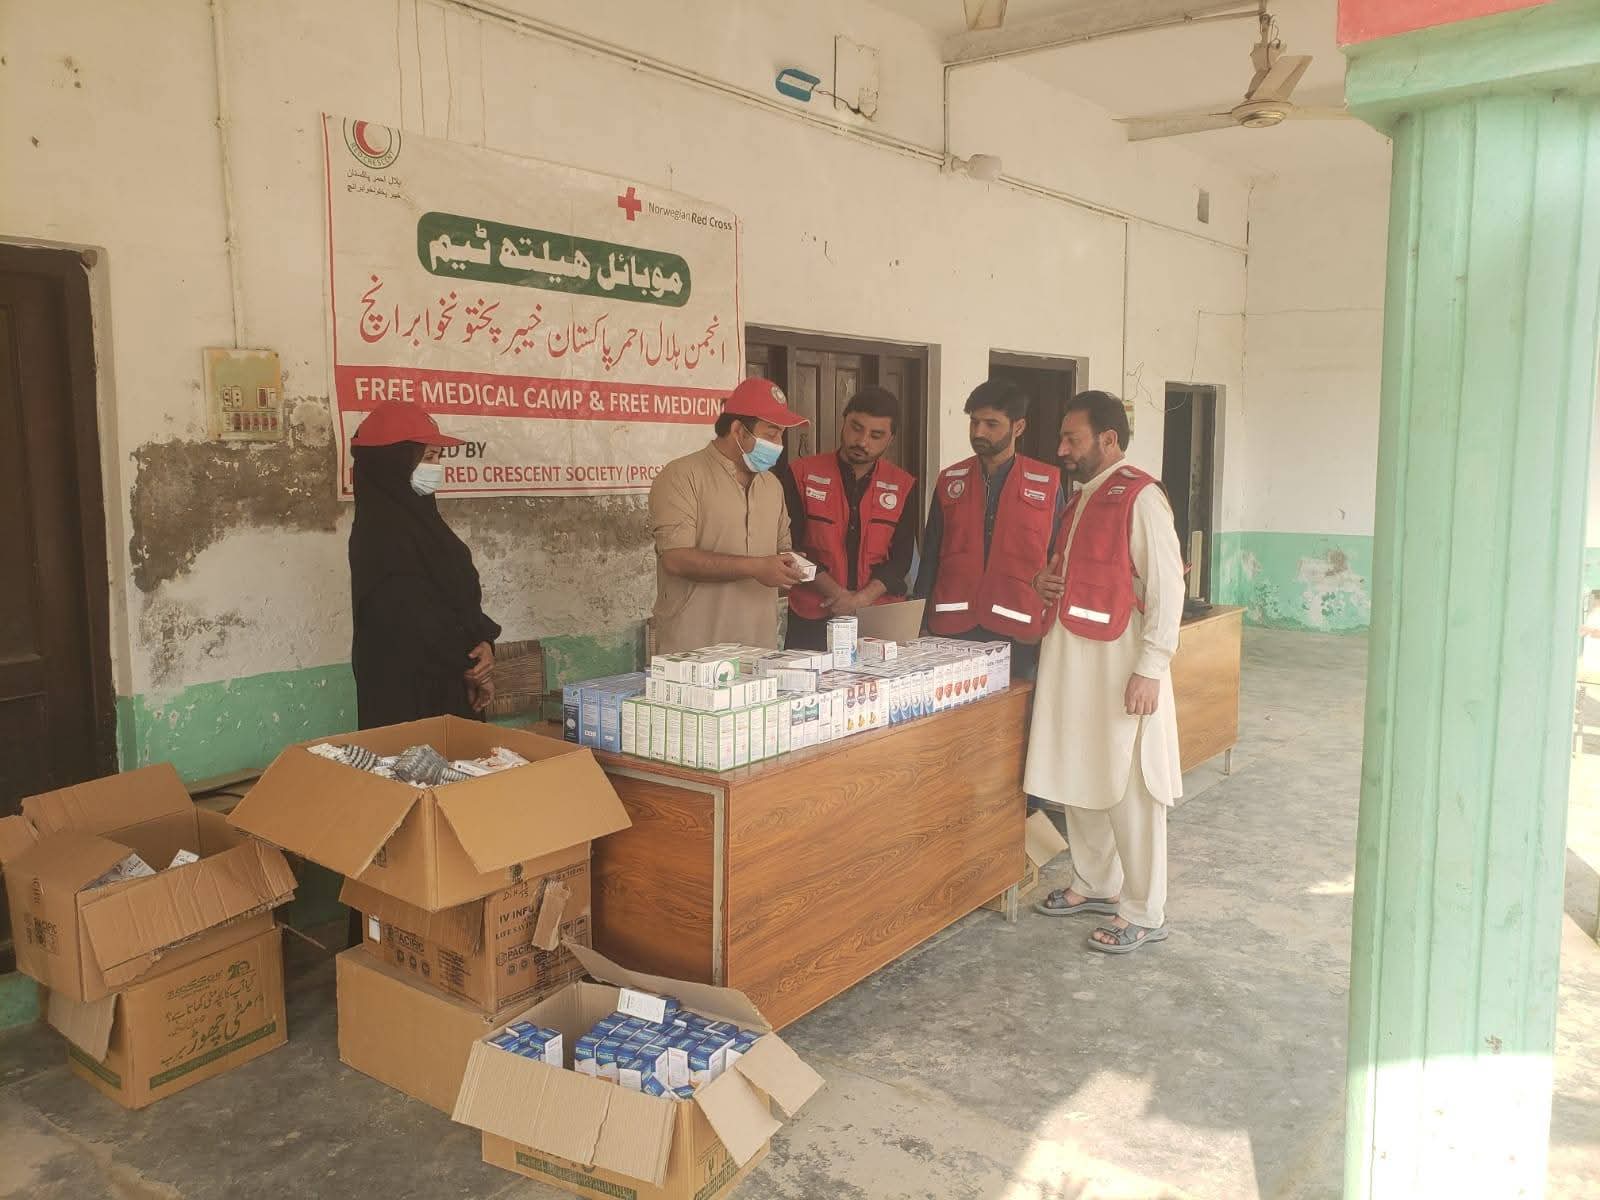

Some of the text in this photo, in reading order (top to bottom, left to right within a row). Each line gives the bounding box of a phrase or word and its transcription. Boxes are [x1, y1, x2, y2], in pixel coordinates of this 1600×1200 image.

[648, 202, 733, 231] Norwegian Red Cross
[429, 222, 491, 272] ٹیم
[597, 252, 684, 298] موبائل
[500, 303, 543, 356] خیبر
[547, 312, 613, 372] پاکستان
[611, 327, 645, 368] احمر
[646, 320, 681, 370] ہلال
[684, 314, 725, 370] انجمن
[355, 377, 725, 417] FREE MEDICAL CAMP & FREE MEDICIN
[465, 441, 487, 459] BY
[445, 466, 478, 484] RED
[483, 465, 561, 483] CRESCENT
[566, 465, 622, 482] SOCIETY
[499, 904, 535, 924] IV INFU
